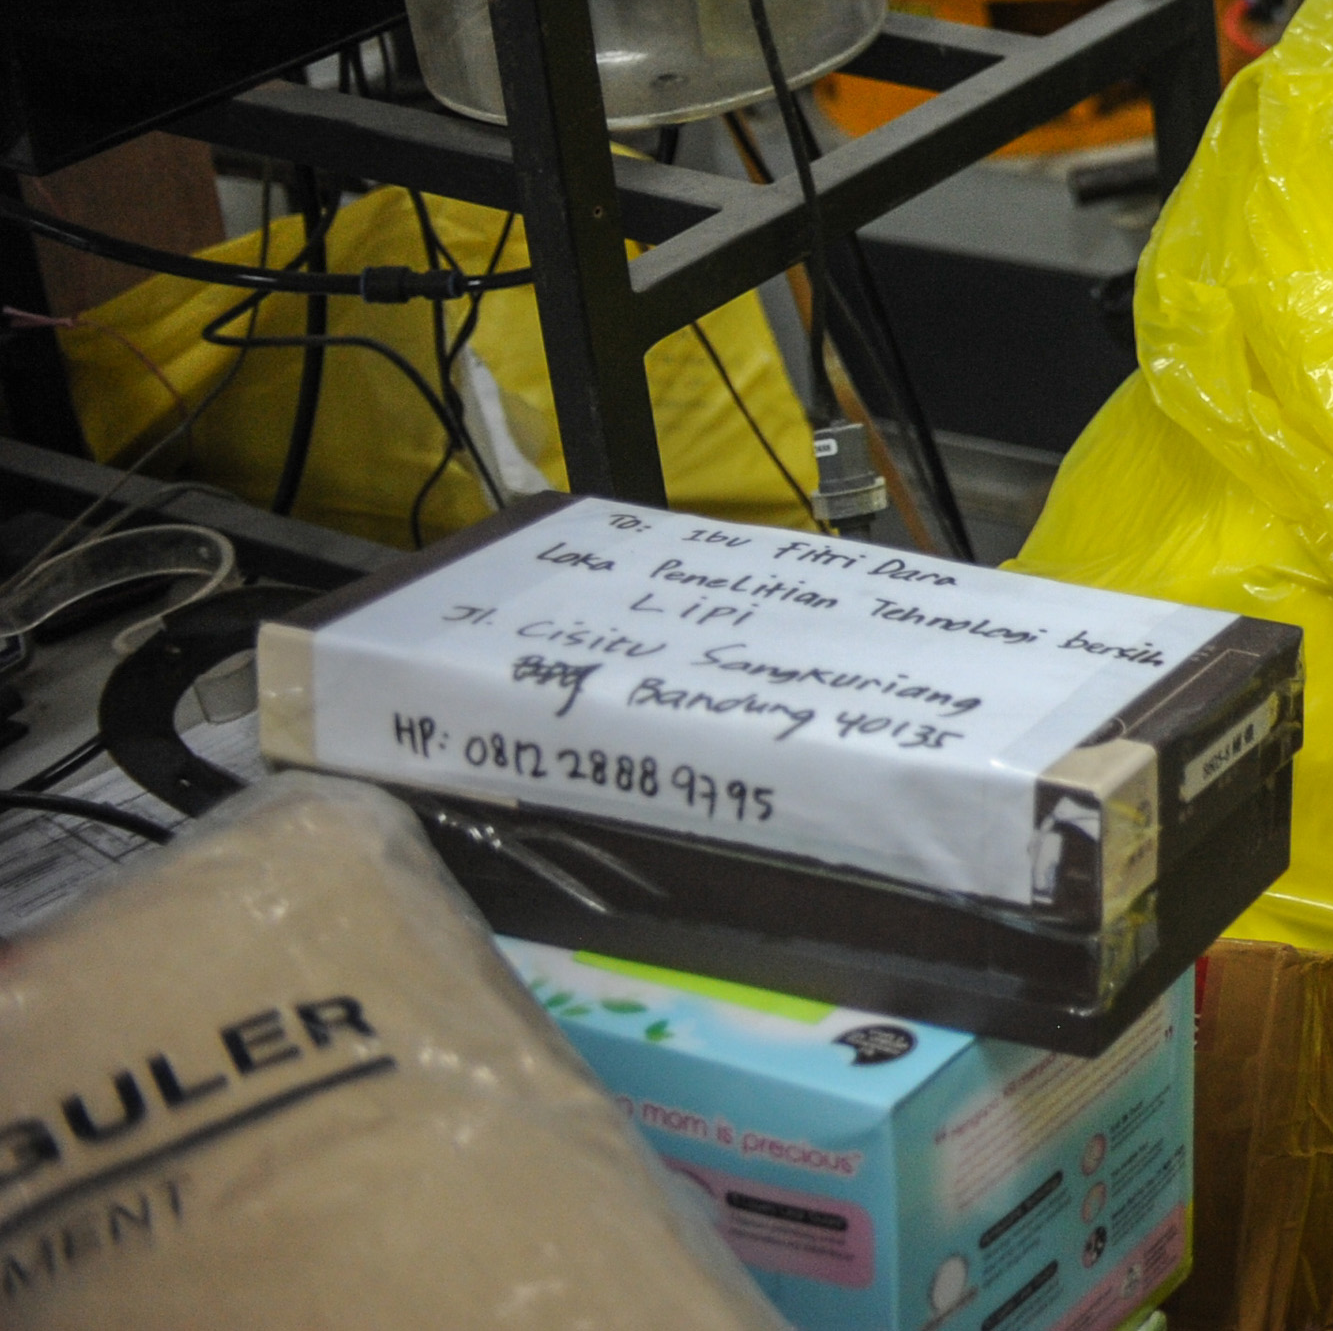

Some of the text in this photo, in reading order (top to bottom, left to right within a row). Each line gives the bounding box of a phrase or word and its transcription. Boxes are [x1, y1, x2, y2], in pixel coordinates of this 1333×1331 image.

[774, 541, 866, 569] Fitri
[867, 558, 957, 587] Dara
[627, 677, 816, 741] Bandung
[835, 711, 966, 749] 40135
[643, 1102, 708, 1138] mom
[716, 1115, 734, 1145] is
